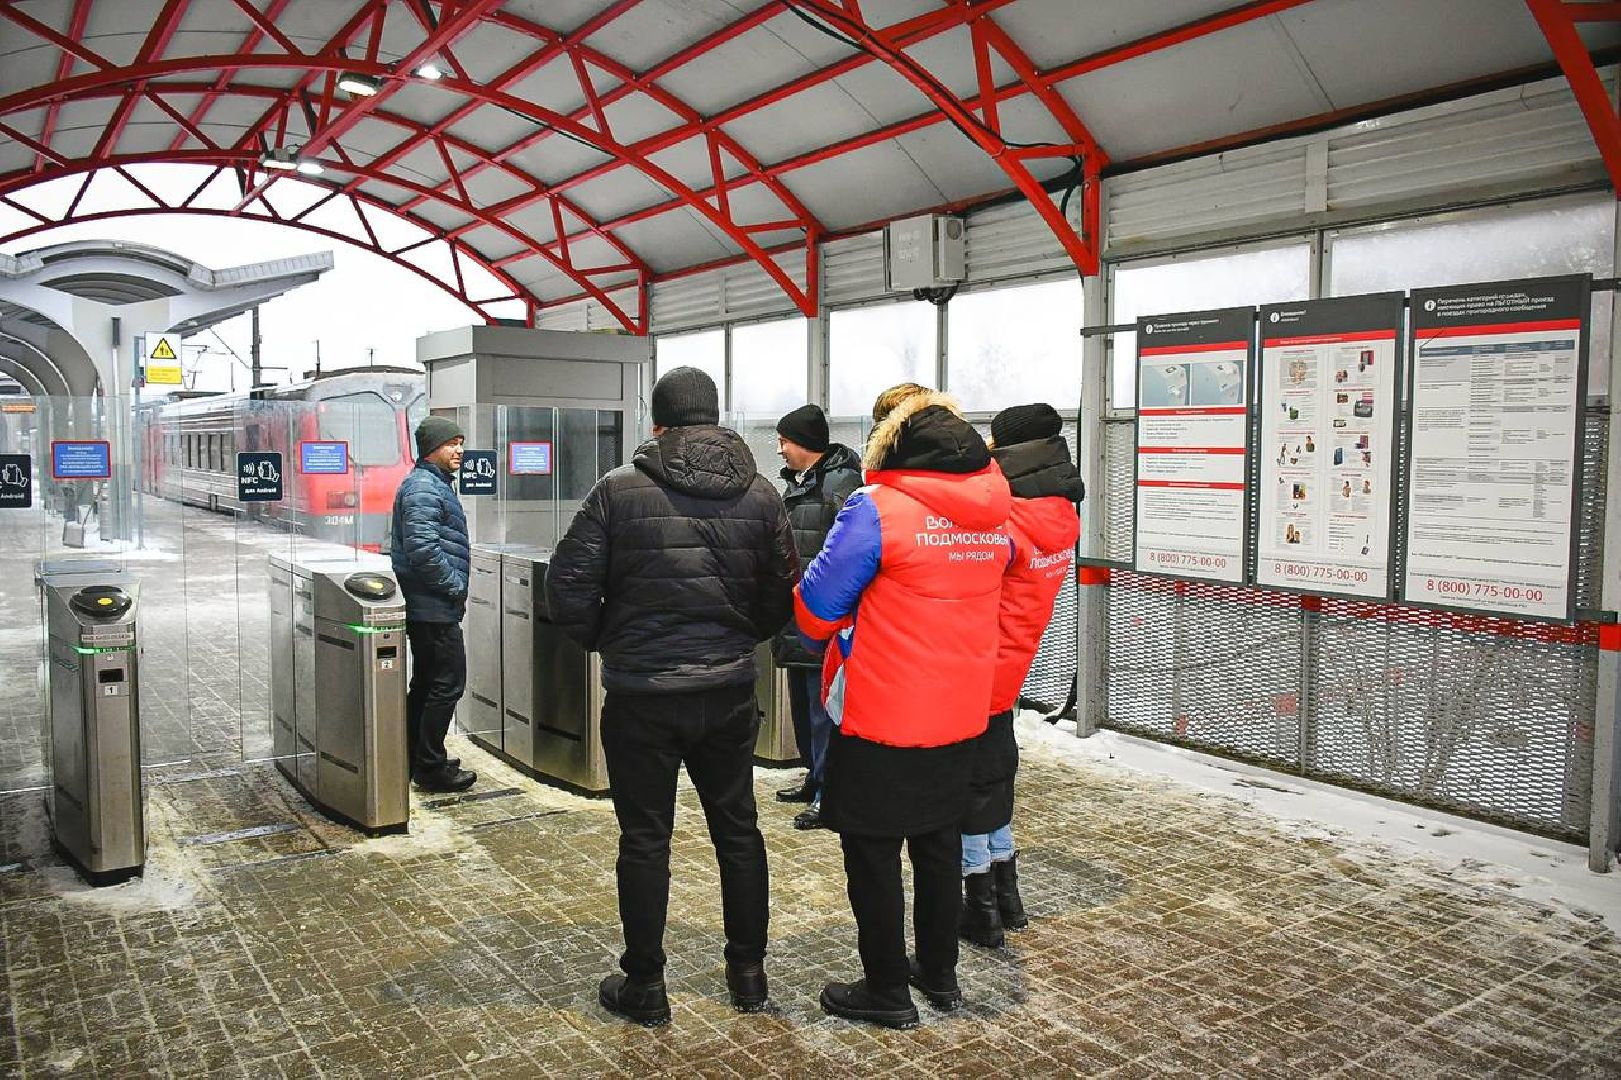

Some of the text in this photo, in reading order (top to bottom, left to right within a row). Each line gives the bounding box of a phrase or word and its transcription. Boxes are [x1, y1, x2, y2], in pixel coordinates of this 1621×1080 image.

[1274, 563, 1281, 574] 8
[1284, 564, 1310, 577] (800)
[1313, 567, 1368, 583] 775-00-00
[1427, 579, 1434, 591] 8
[1438, 580, 1470, 596] (800)
[1475, 583, 1543, 601] 775-00-00
